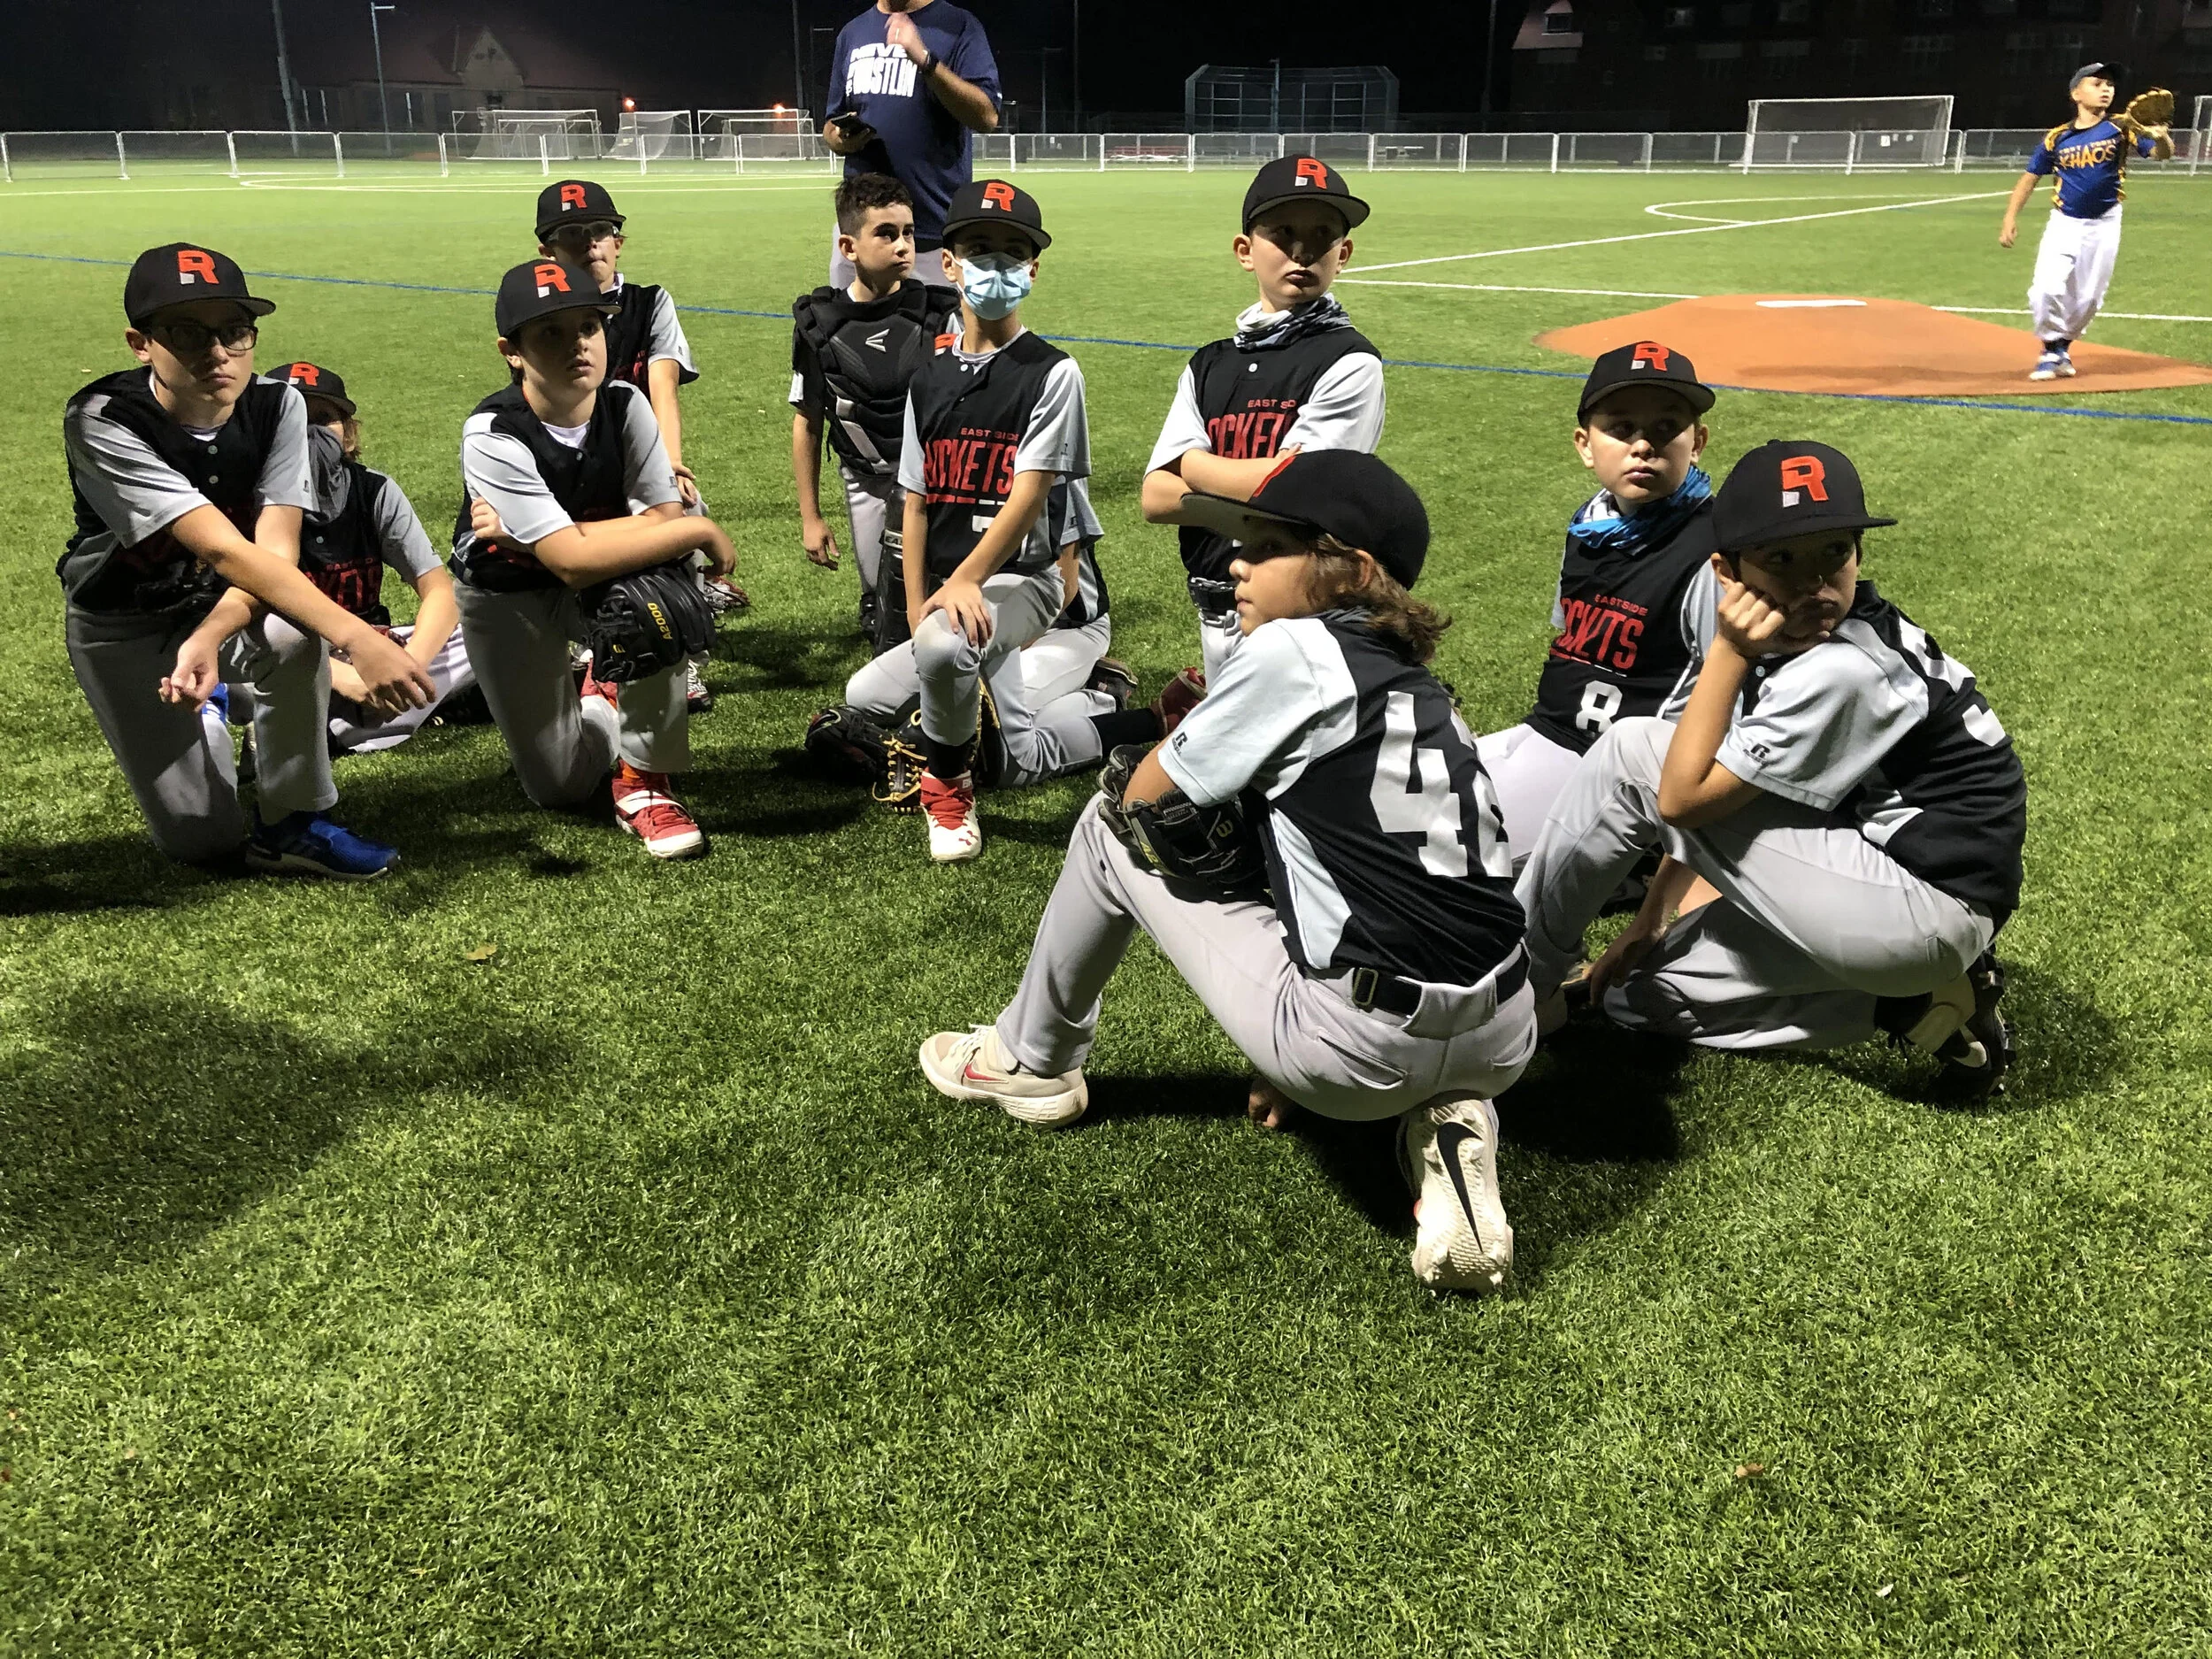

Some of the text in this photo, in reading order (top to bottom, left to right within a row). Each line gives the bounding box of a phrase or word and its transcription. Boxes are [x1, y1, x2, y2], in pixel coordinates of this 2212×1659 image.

[1294, 158, 1327, 189] R
[561, 184, 588, 211] R
[981, 182, 1015, 211] R
[177, 250, 219, 284] R
[534, 264, 572, 298] R
[1631, 342, 1670, 372] R
[288, 361, 319, 386] R
[1248, 399, 1278, 408] EAST
[960, 426, 991, 437] EAST
[1781, 456, 1829, 508] R
[648, 603, 672, 640] A2000
[1576, 680, 1623, 733] 8
